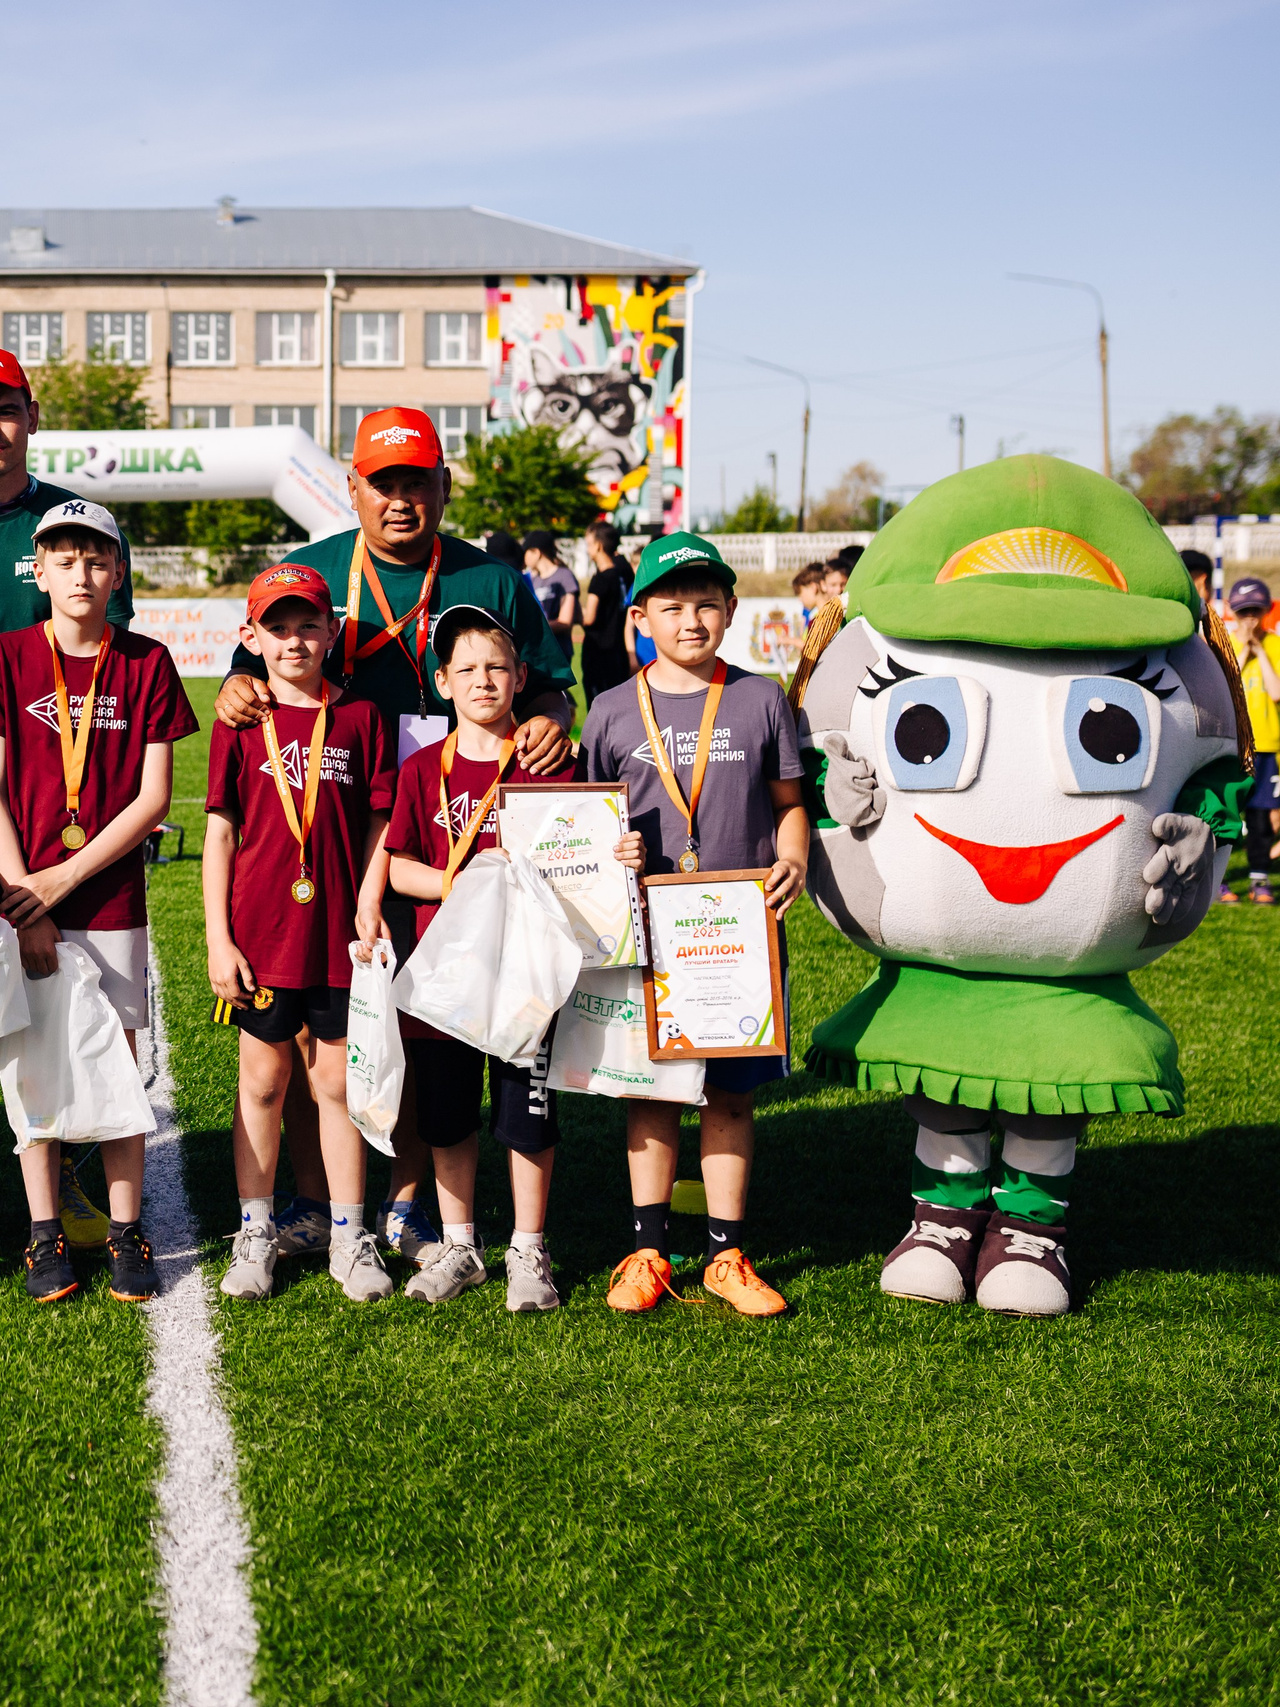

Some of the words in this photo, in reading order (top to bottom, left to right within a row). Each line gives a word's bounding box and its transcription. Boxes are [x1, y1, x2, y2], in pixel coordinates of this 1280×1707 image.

[384, 434, 407, 446] 2025
[27, 446, 204, 479] ЕТРОШКА
[139, 609, 202, 624] ТВУЕМ
[70, 695, 117, 707] РУСКАЯ
[69, 707, 114, 718] МЕНАЯ
[70, 718, 127, 731] КОПАНИЯ
[676, 728, 731, 743] РУСАЯ
[302, 746, 350, 760] РСКАЯ
[677, 739, 729, 754] МЕАЯ
[303, 758, 348, 772] МДНАЯ
[677, 750, 745, 766] КОАНИЯ
[535, 837, 592, 851] ЕТРОШКА
[547, 848, 576, 861] 2025
[538, 862, 599, 879] ИПЛОМ
[693, 925, 721, 938] 2025
[676, 944, 744, 958] ДИПЛОМ
[528, 1041, 549, 1120] PORT
